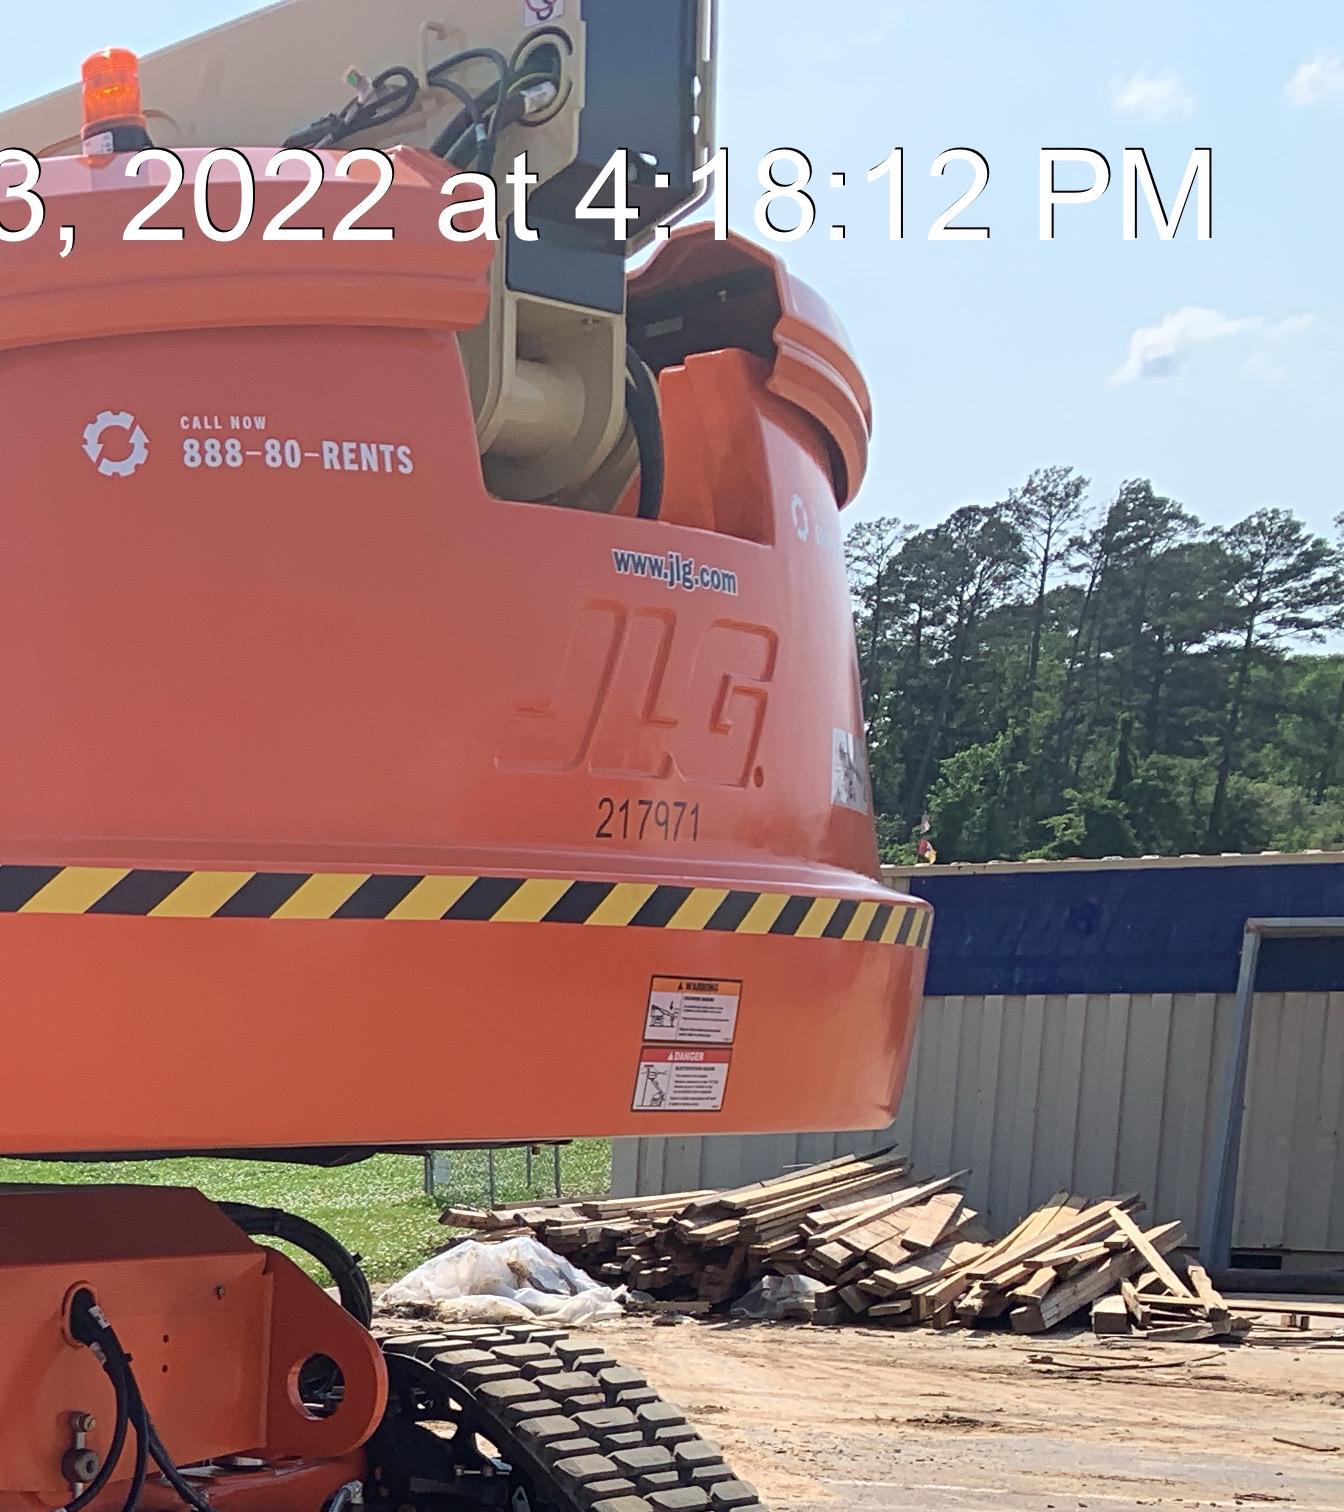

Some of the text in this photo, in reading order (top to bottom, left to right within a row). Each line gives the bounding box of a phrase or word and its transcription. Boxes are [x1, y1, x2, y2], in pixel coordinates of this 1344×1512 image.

[180, 415, 267, 430] CALL NOW
[182, 437, 414, 475] 888-80-RENTS
[612, 548, 738, 595] www.jlg.com
[595, 796, 701, 842] 217971
